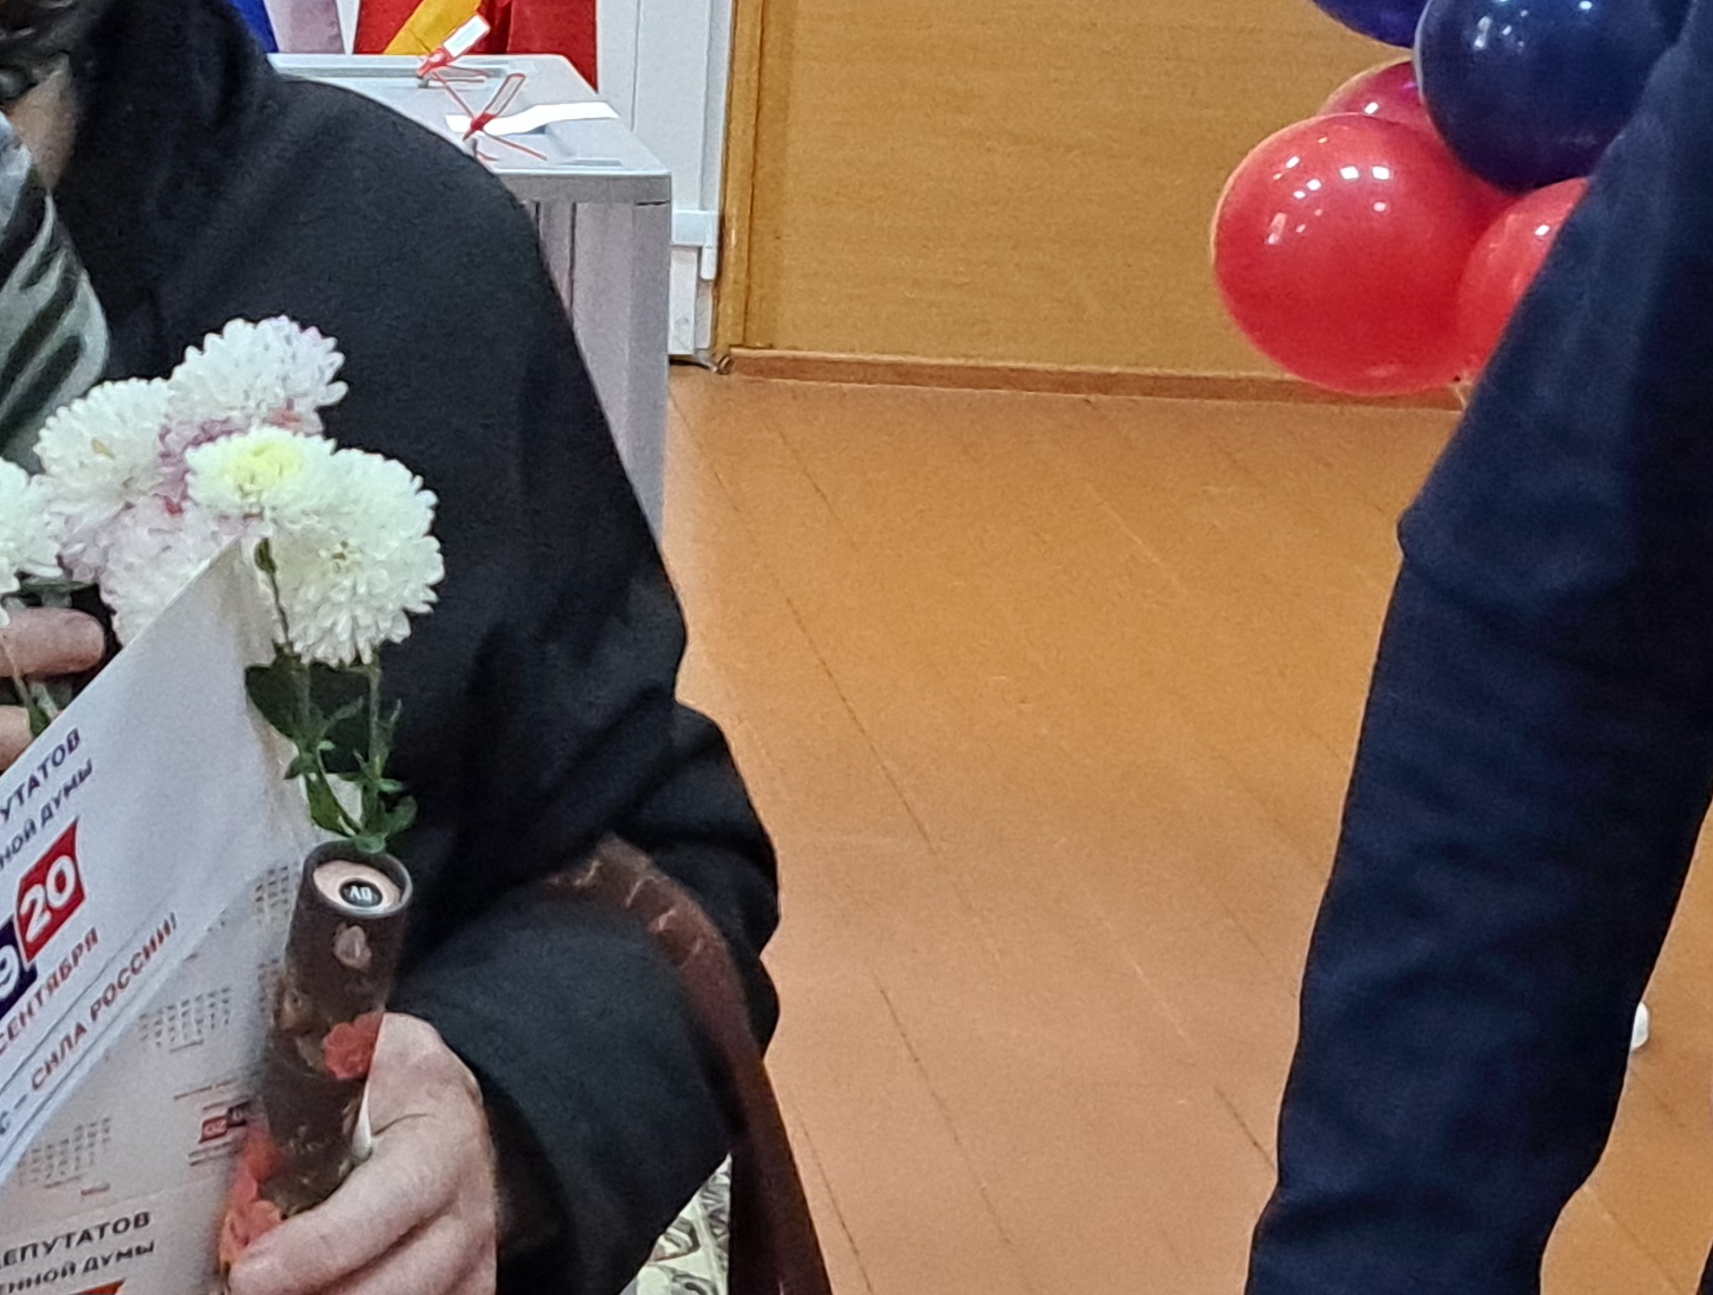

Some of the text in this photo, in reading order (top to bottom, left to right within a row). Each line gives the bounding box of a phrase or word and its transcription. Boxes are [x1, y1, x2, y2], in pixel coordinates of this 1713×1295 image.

[40, 758, 93, 828] ДУМЫ
[20, 855, 77, 943] 20
[31, 1022, 87, 1090] СИЛА
[83, 1240, 154, 1274] ДУМЫ
